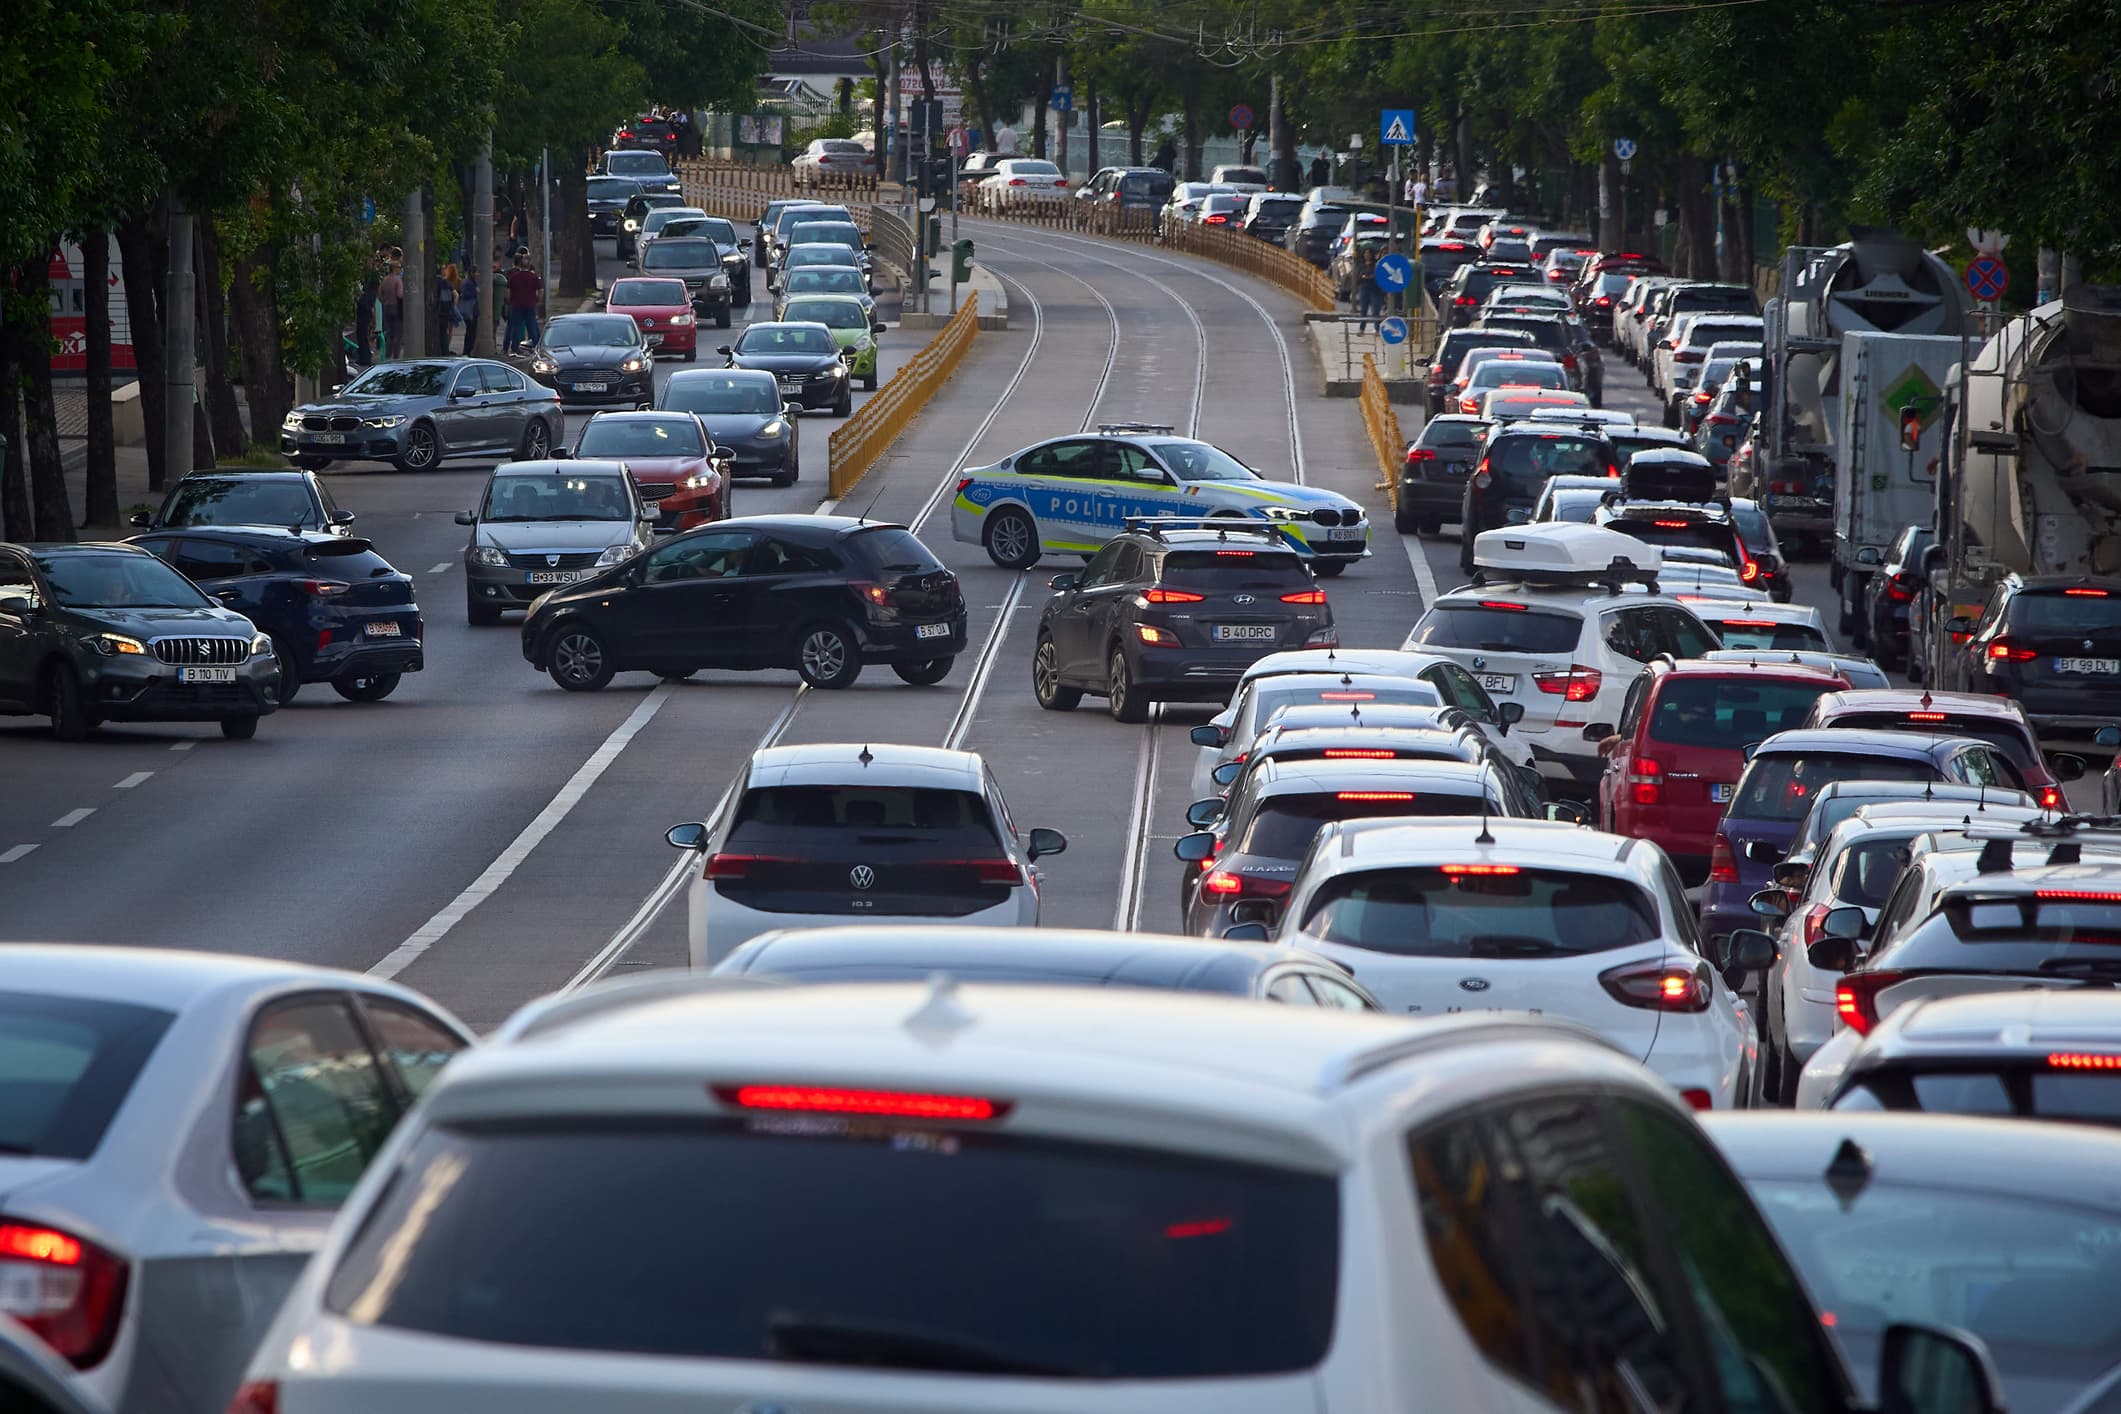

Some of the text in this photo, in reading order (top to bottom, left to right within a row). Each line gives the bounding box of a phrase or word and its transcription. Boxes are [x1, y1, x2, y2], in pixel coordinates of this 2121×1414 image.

[532, 573, 540, 582] B
[556, 572, 578, 583] WSU
[920, 626, 927, 637] B
[1222, 627, 1272, 638] B 40 DRC
[2079, 660, 2093, 670] 99
[188, 668, 229, 680] B 110 TIV
[1485, 676, 1508, 690] BFL
[1721, 785, 1731, 797] B
